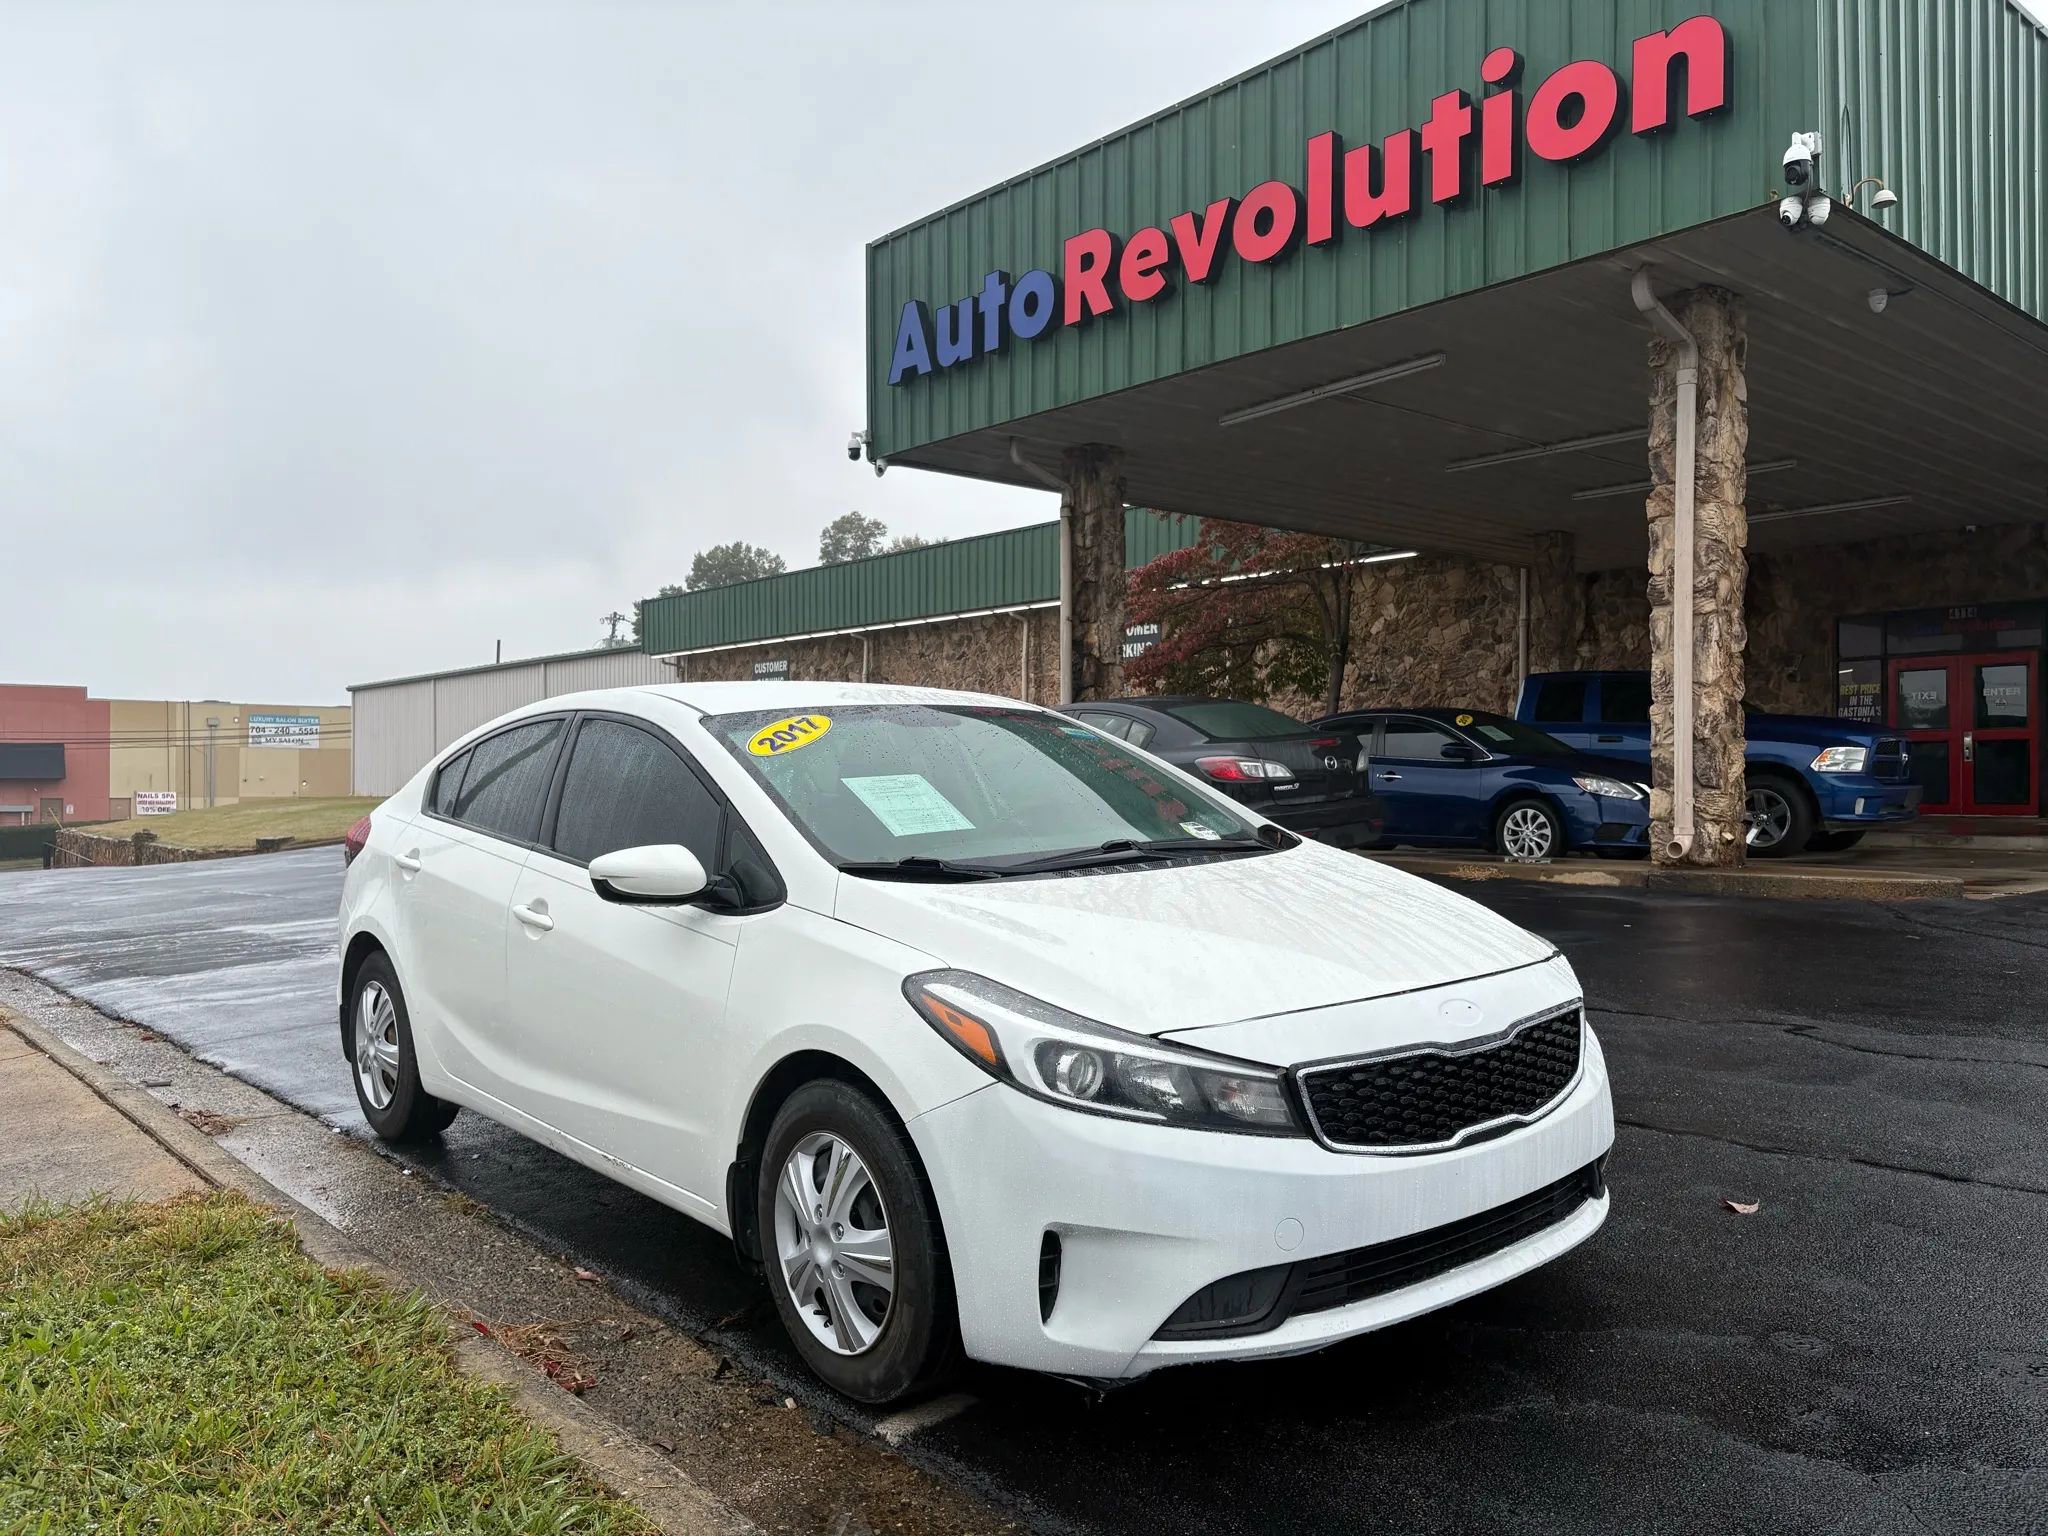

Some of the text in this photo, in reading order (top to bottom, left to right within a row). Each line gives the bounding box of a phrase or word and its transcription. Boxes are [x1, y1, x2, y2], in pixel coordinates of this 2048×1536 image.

[754, 660, 788, 674] CUSTOMER
[1840, 683, 1881, 696] BEST PRICE
[1983, 687, 2021, 697] ENTER
[1859, 695, 1874, 706] THE
[757, 717, 820, 752] 2017
